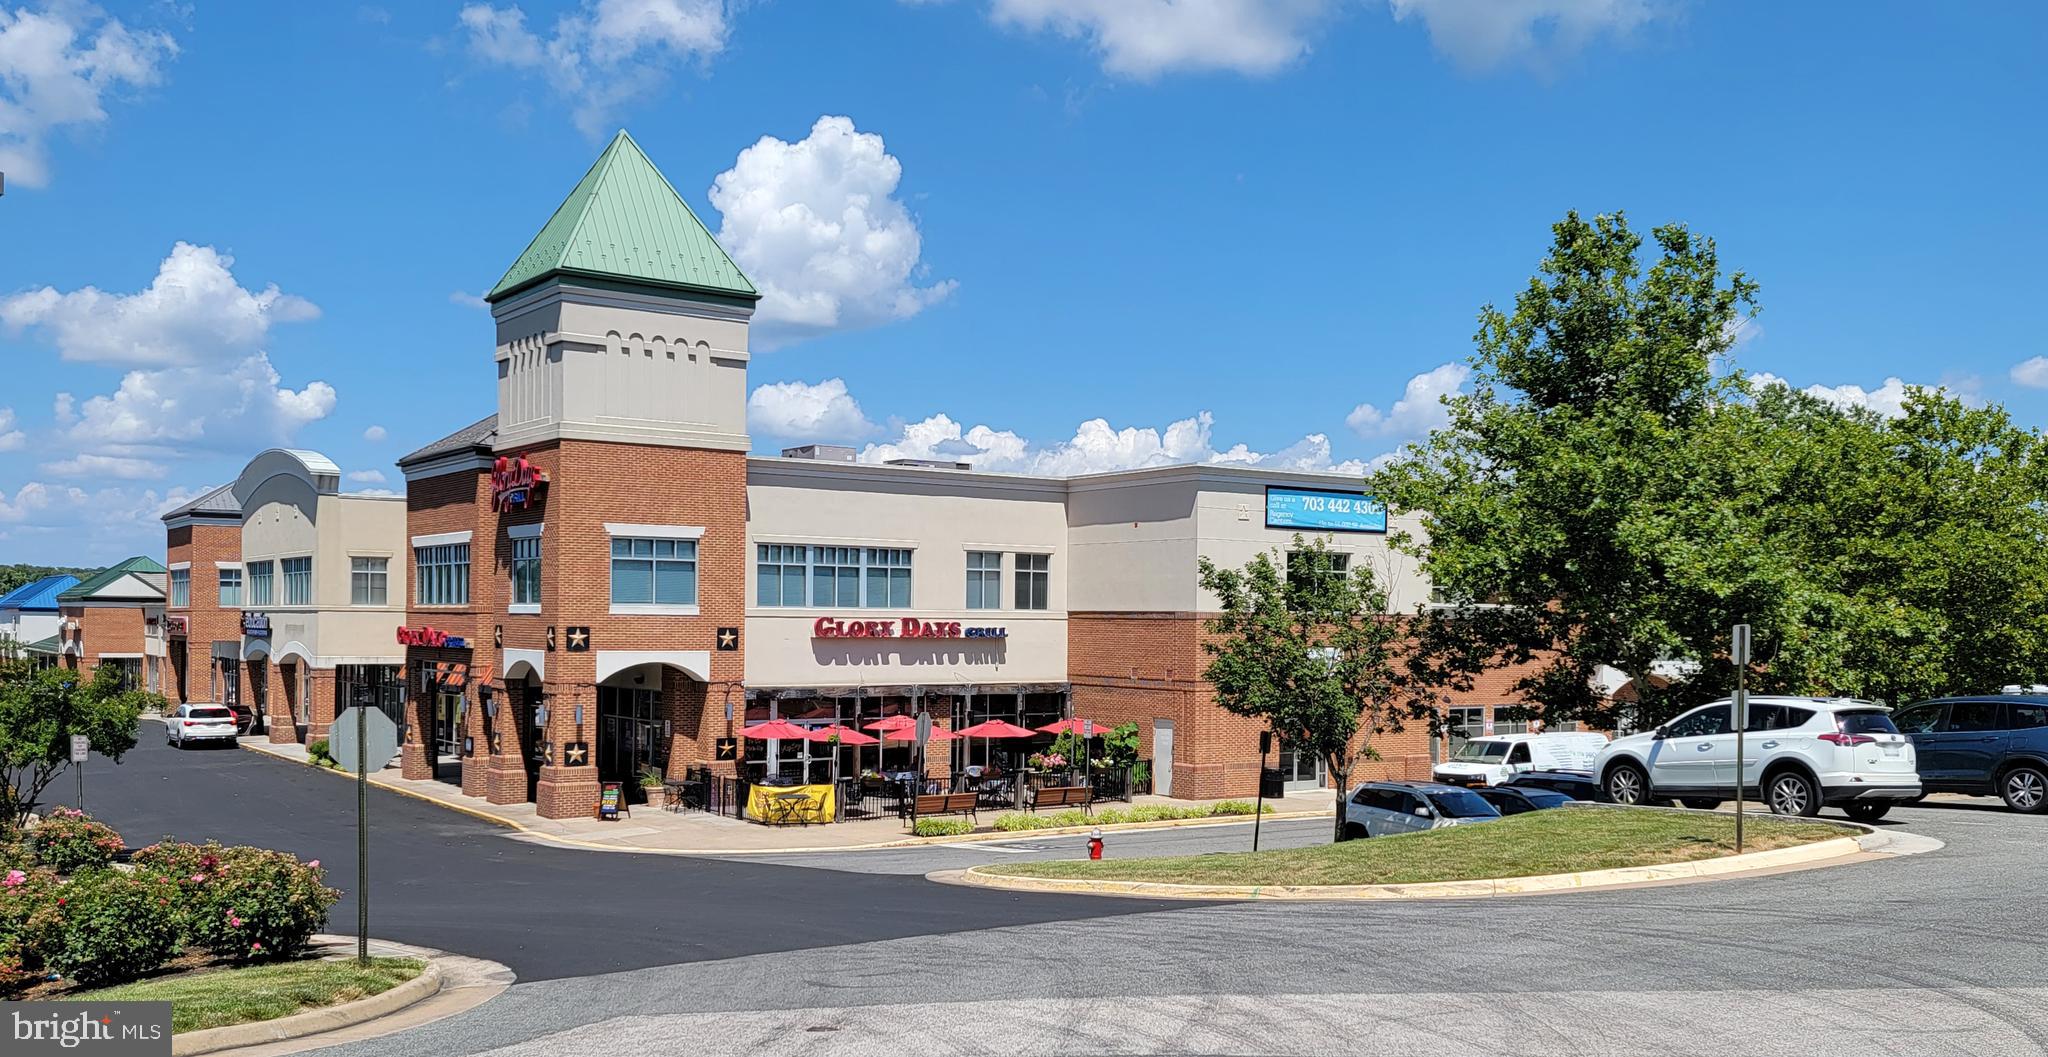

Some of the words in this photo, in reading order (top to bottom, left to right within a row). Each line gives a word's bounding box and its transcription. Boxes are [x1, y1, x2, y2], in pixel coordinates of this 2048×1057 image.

[1302, 496, 1325, 512] 703
[1328, 499, 1350, 513] 442
[814, 617, 896, 638] GLORY
[901, 617, 961, 638] DAYS
[964, 627, 1008, 638] GRILL
